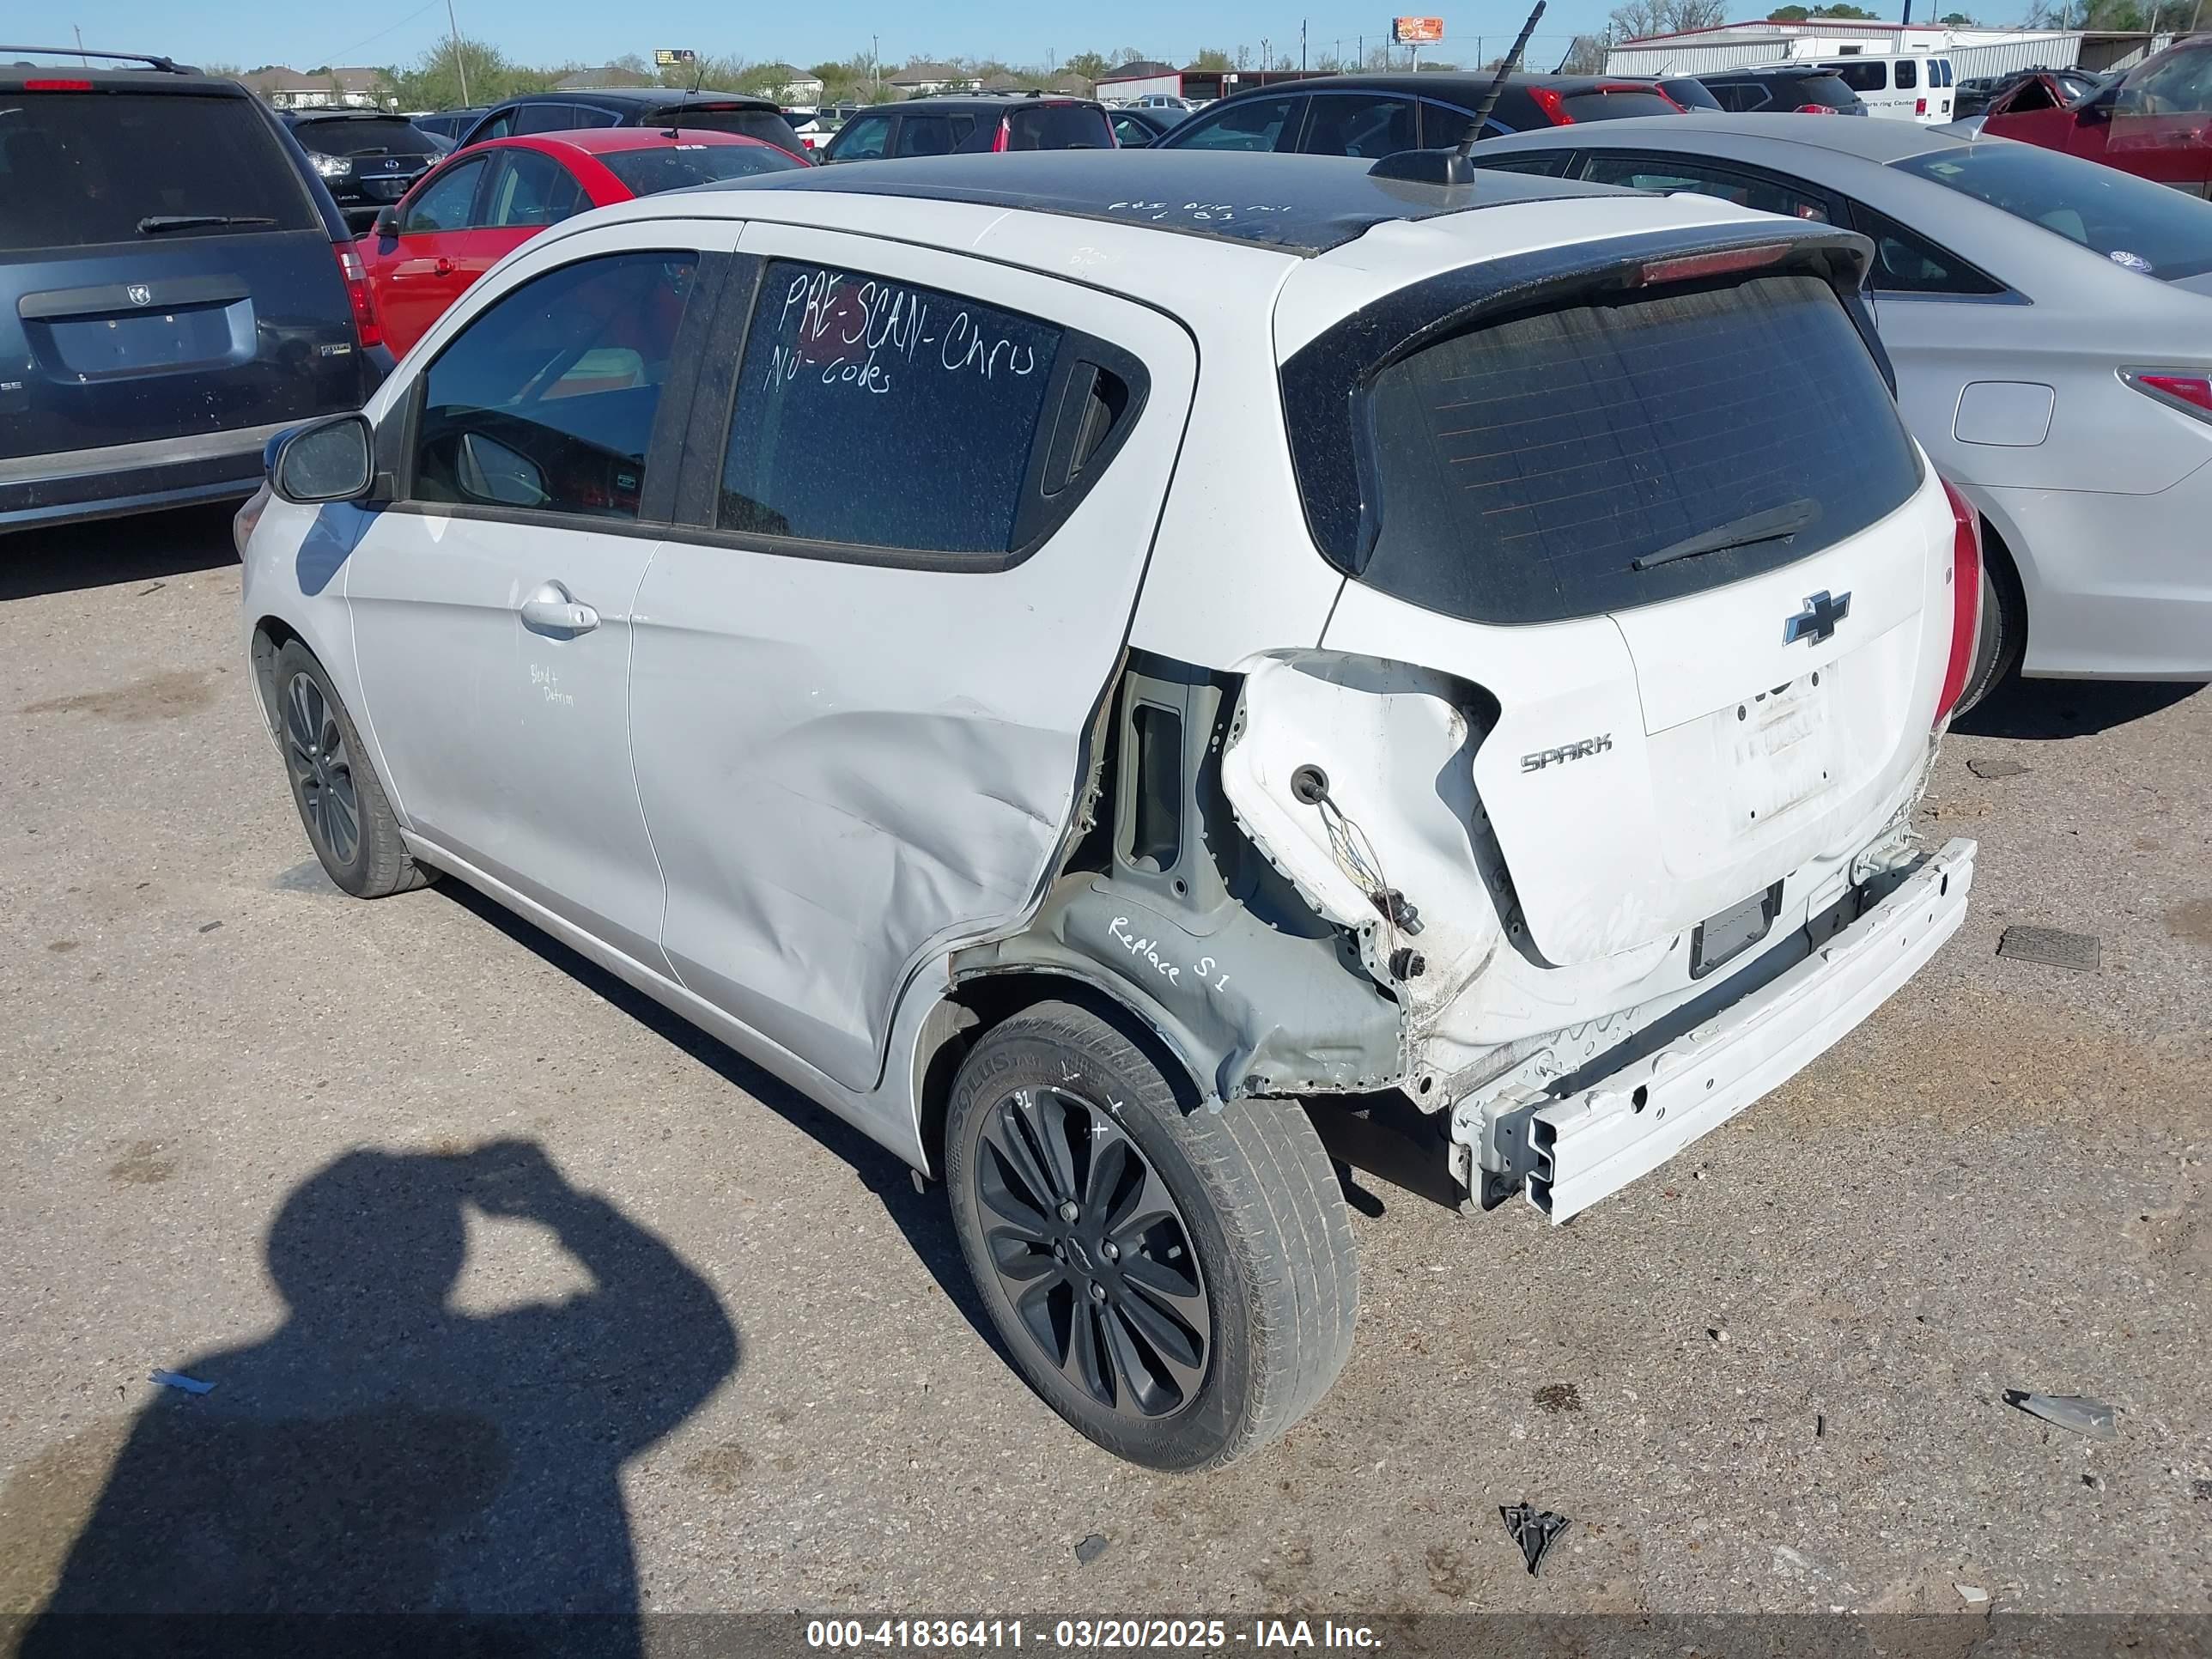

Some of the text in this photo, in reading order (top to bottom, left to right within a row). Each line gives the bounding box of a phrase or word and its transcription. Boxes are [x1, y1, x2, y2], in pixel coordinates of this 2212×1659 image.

[1521, 732, 1612, 774] SPARK
[1109, 916, 1180, 987] Replace
[951, 1051, 1010, 1131] SOLUS
